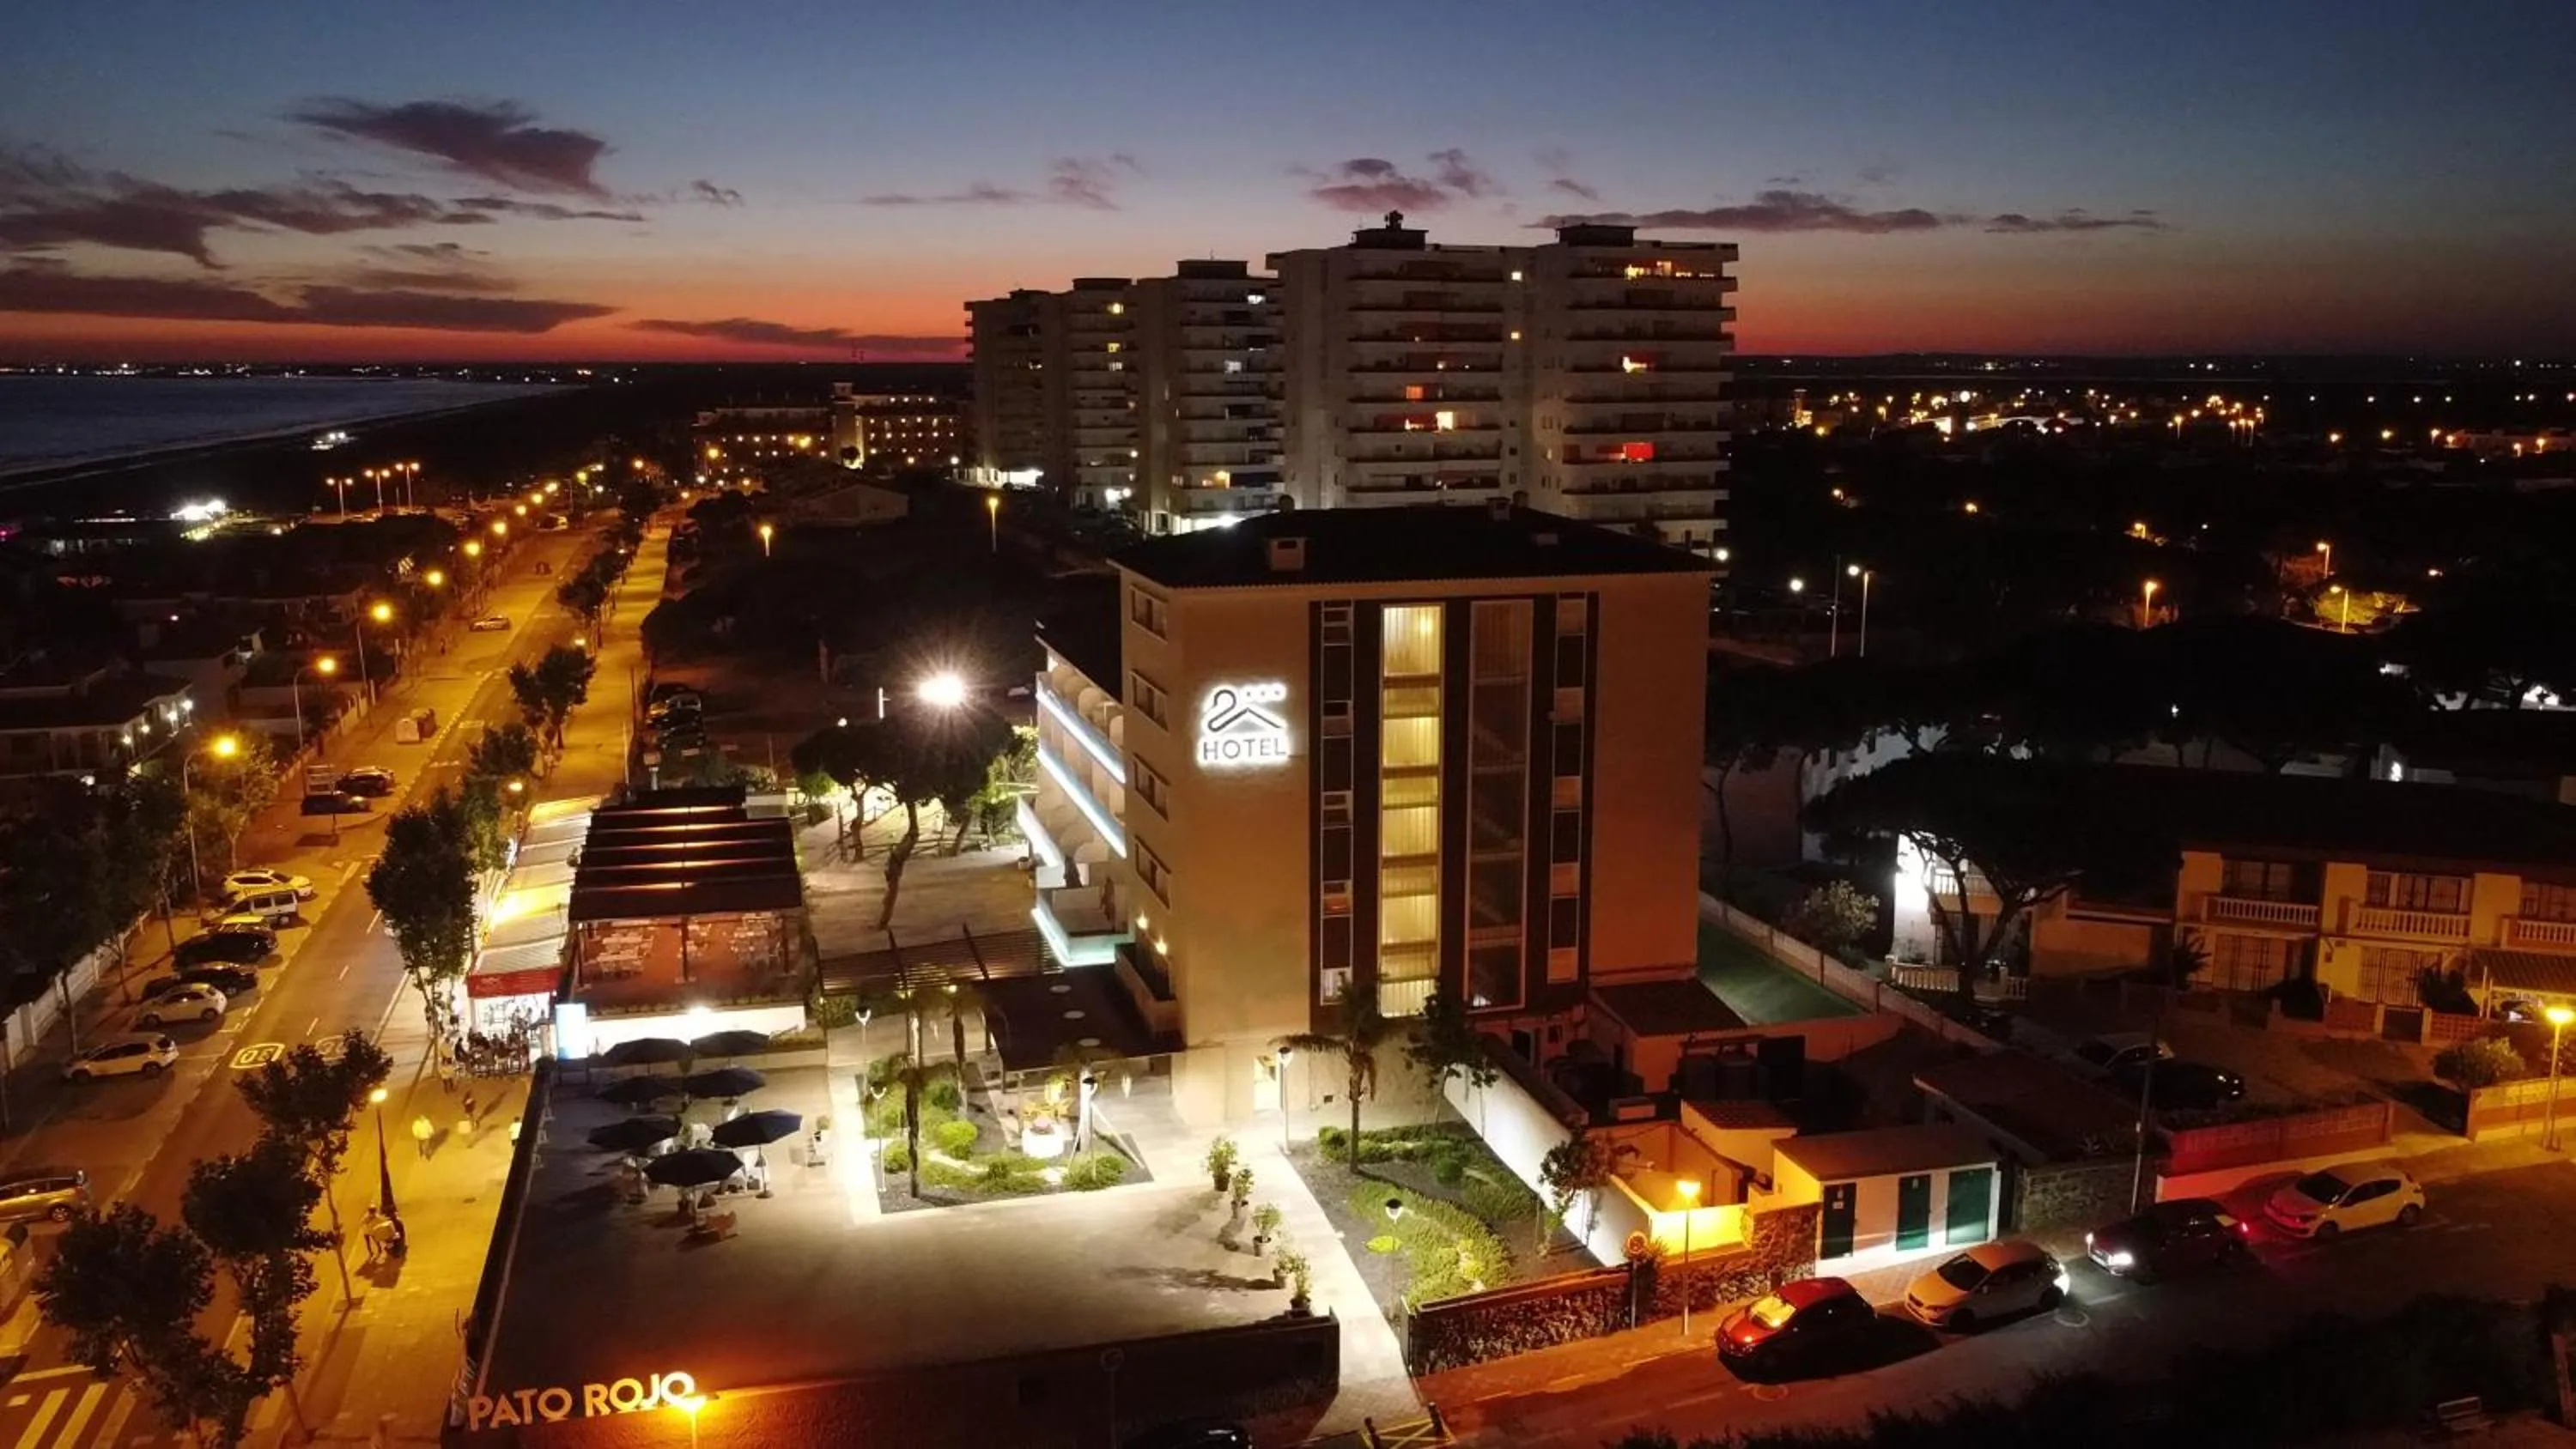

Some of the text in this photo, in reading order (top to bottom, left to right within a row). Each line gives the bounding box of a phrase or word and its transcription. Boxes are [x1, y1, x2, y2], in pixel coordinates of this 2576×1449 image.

[1203, 737, 1286, 761] HOTEL
[468, 1387, 573, 1432] PATO
[583, 1371, 696, 1418] ROJO
